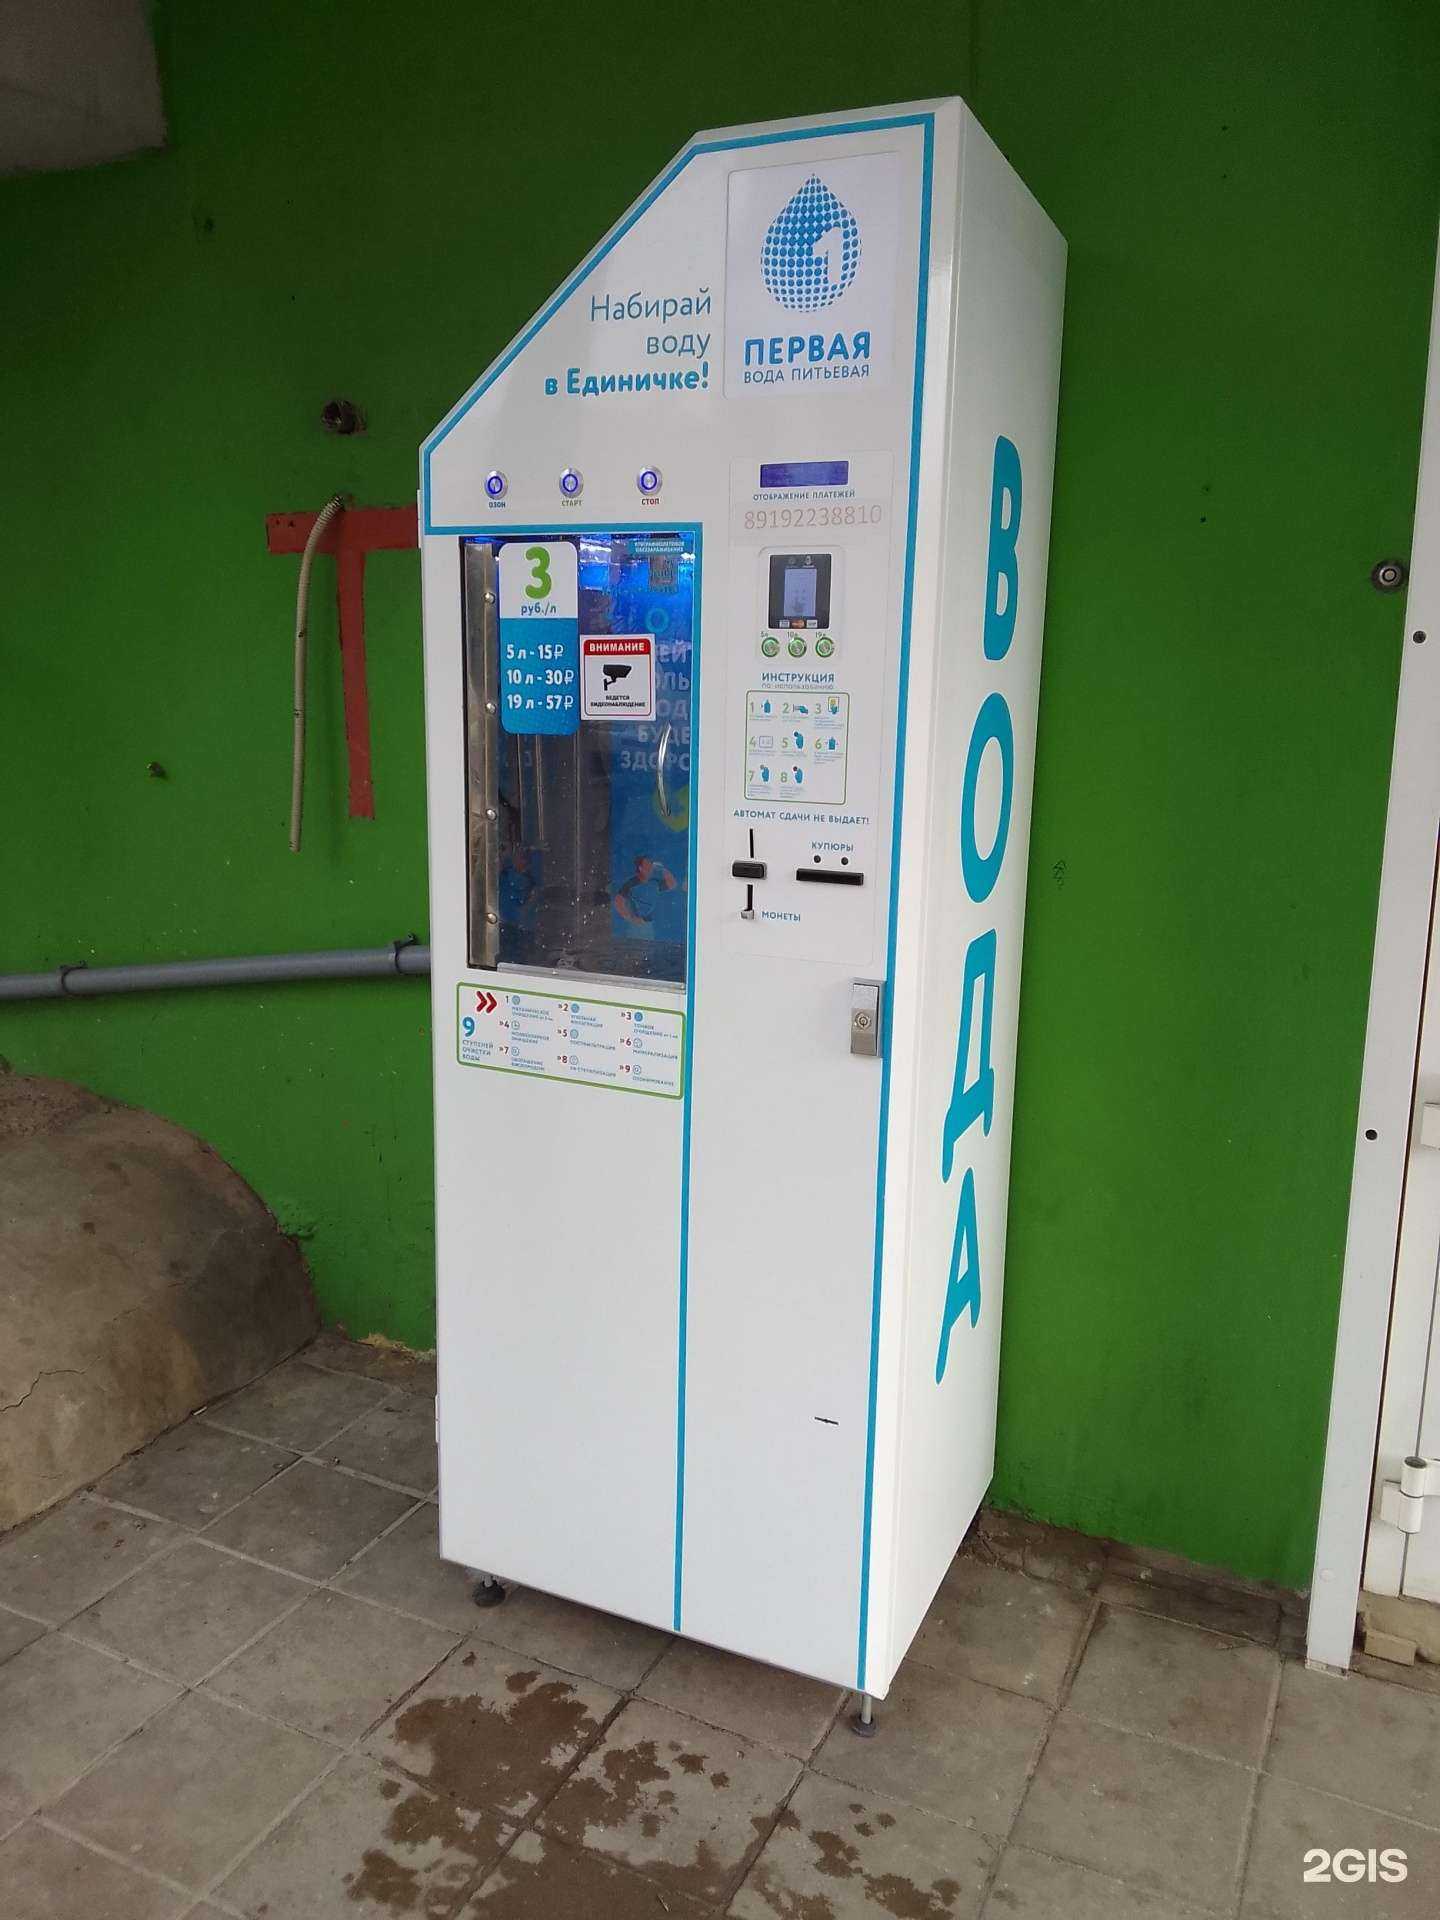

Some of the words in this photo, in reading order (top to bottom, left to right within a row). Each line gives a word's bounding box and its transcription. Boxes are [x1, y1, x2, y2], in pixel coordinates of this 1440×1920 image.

[590, 287, 711, 323] Набирай
[646, 331, 711, 359] воду
[744, 331, 872, 367] ПЕРВАЯ
[545, 376, 558, 395] в
[566, 361, 709, 397] Единичке!
[744, 369, 785, 384] ВОДА
[791, 364, 870, 382] ПИТЬЕВАЯ
[753, 492, 809, 501] ОТОБРАЖЕНИЕ
[812, 489, 855, 499] ПЛАТЕЖЕЙ
[488, 501, 506, 509] ОЗОН
[641, 498, 660, 506] СТОП
[744, 504, 882, 530] 89192238810
[524, 546, 552, 599] 3
[521, 602, 557, 617] руб./л
[506, 644, 514, 660] 5
[517, 649, 526, 660] л
[590, 643, 645, 652] ВНИМАНИЕ
[507, 669, 522, 685] 10
[525, 673, 534, 685] л
[761, 672, 835, 684] ИНСТРУКЦИЯ
[507, 694, 522, 710] 19
[525, 699, 534, 710] л
[749, 702, 755, 713] 1
[782, 703, 789, 714] 2
[815, 703, 822, 714] 3
[749, 736, 757, 748] 4
[781, 738, 789, 749] 5
[814, 739, 822, 750] 6
[749, 771, 755, 782] 7
[780, 772, 788, 783] 8
[733, 809, 777, 820] АВТОМАТ
[779, 812, 810, 822] СДАЧИ
[813, 814, 825, 823] НЕ
[828, 814, 870, 826] ВЫДАЕТ!
[811, 841, 854, 852] КУПЮРЫ
[761, 911, 801, 922] МОНЕТЫ
[462, 1016, 475, 1038] 9
